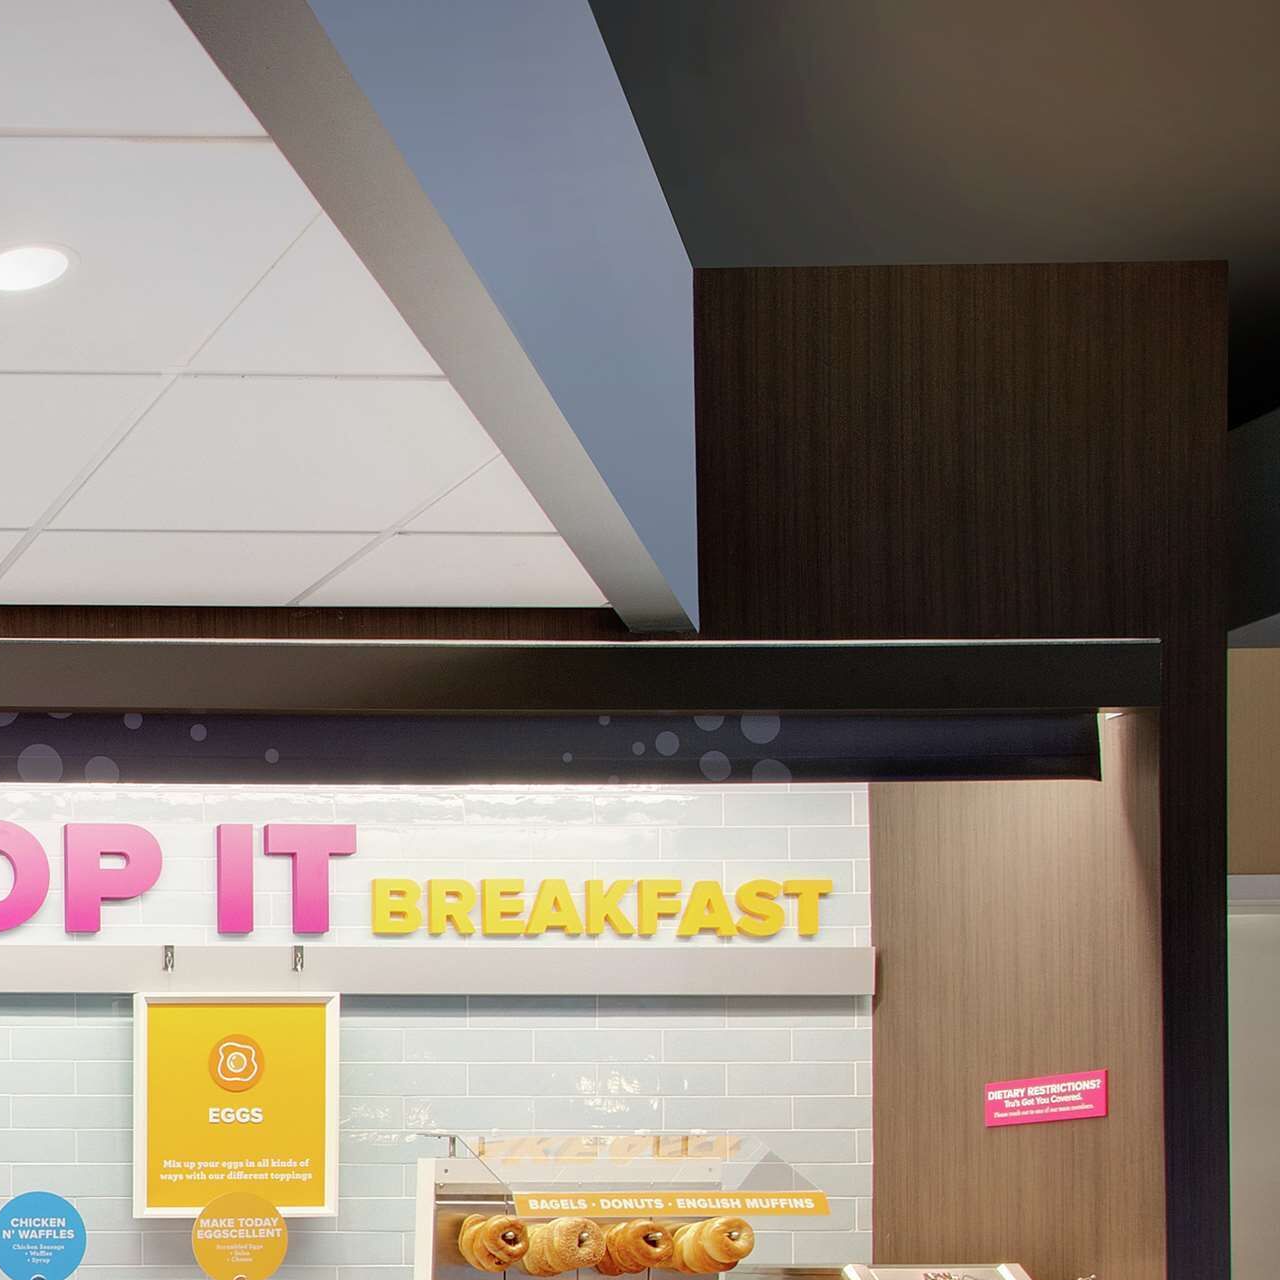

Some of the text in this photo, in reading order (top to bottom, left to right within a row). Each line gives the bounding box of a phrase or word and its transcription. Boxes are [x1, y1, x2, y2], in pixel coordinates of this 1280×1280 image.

[217, 822, 357, 933] IT
[372, 878, 833, 936] BREAKFAST
[988, 1079, 1102, 1101] DIETARY RESTRICTIONS?
[1004, 1098, 1020, 1108] Tru's
[1022, 1098, 1035, 1106] Got
[1035, 1096, 1050, 1105] You
[208, 1108, 263, 1123] EGGS
[163, 1159, 310, 1171] Mix up your eggs in all kinds of
[160, 1173, 184, 1182] ways
[185, 1171, 206, 1180] with
[227, 1171, 269, 1180] different
[270, 1171, 312, 1182] toppings
[528, 1197, 815, 1210] BAGELS DONUTS ENGLISH MUFFINS
[10, 1217, 66, 1228] CHICKEN
[200, 1217, 279, 1228] MAKE TODAY
[2, 1229, 75, 1239] N' WAFFLES
[197, 1228, 282, 1239] EGGSCELLENT
